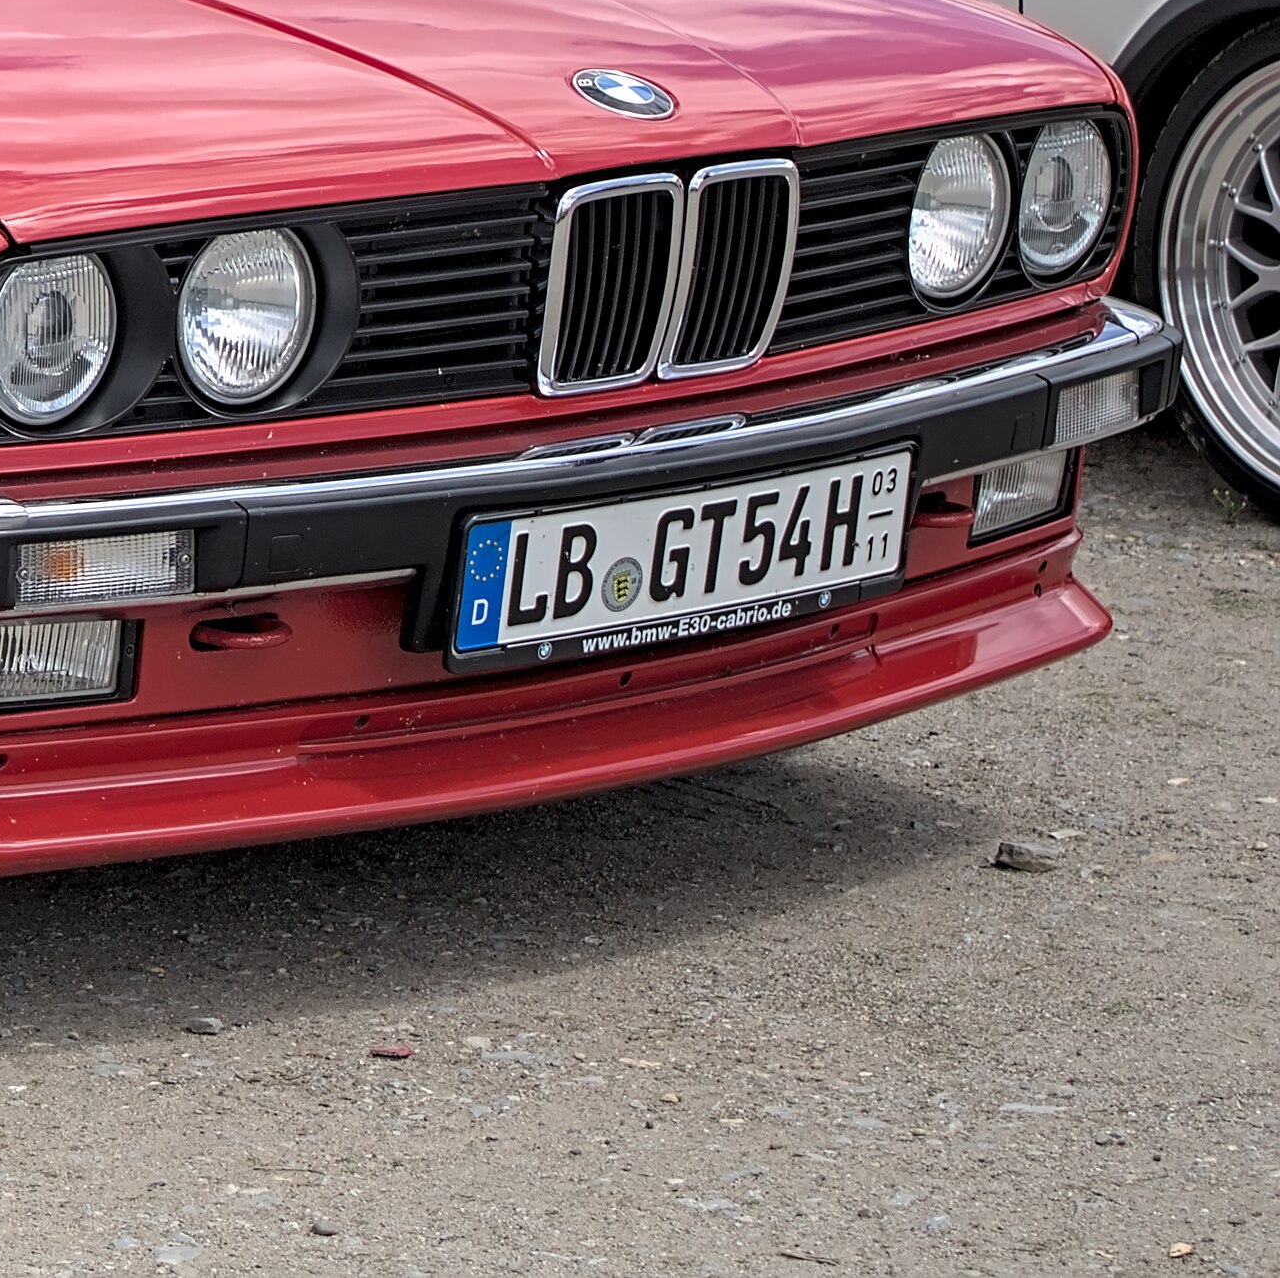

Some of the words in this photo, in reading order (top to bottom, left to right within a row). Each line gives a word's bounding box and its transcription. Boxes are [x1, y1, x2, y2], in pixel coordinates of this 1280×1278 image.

[871, 467, 897, 497] 03
[471, 598, 489, 626] D
[506, 522, 599, 627] LB
[648, 474, 864, 603] GT54H
[866, 532, 890, 563] 11
[582, 599, 793, 654] www.bmw-E30-cabrio.de
